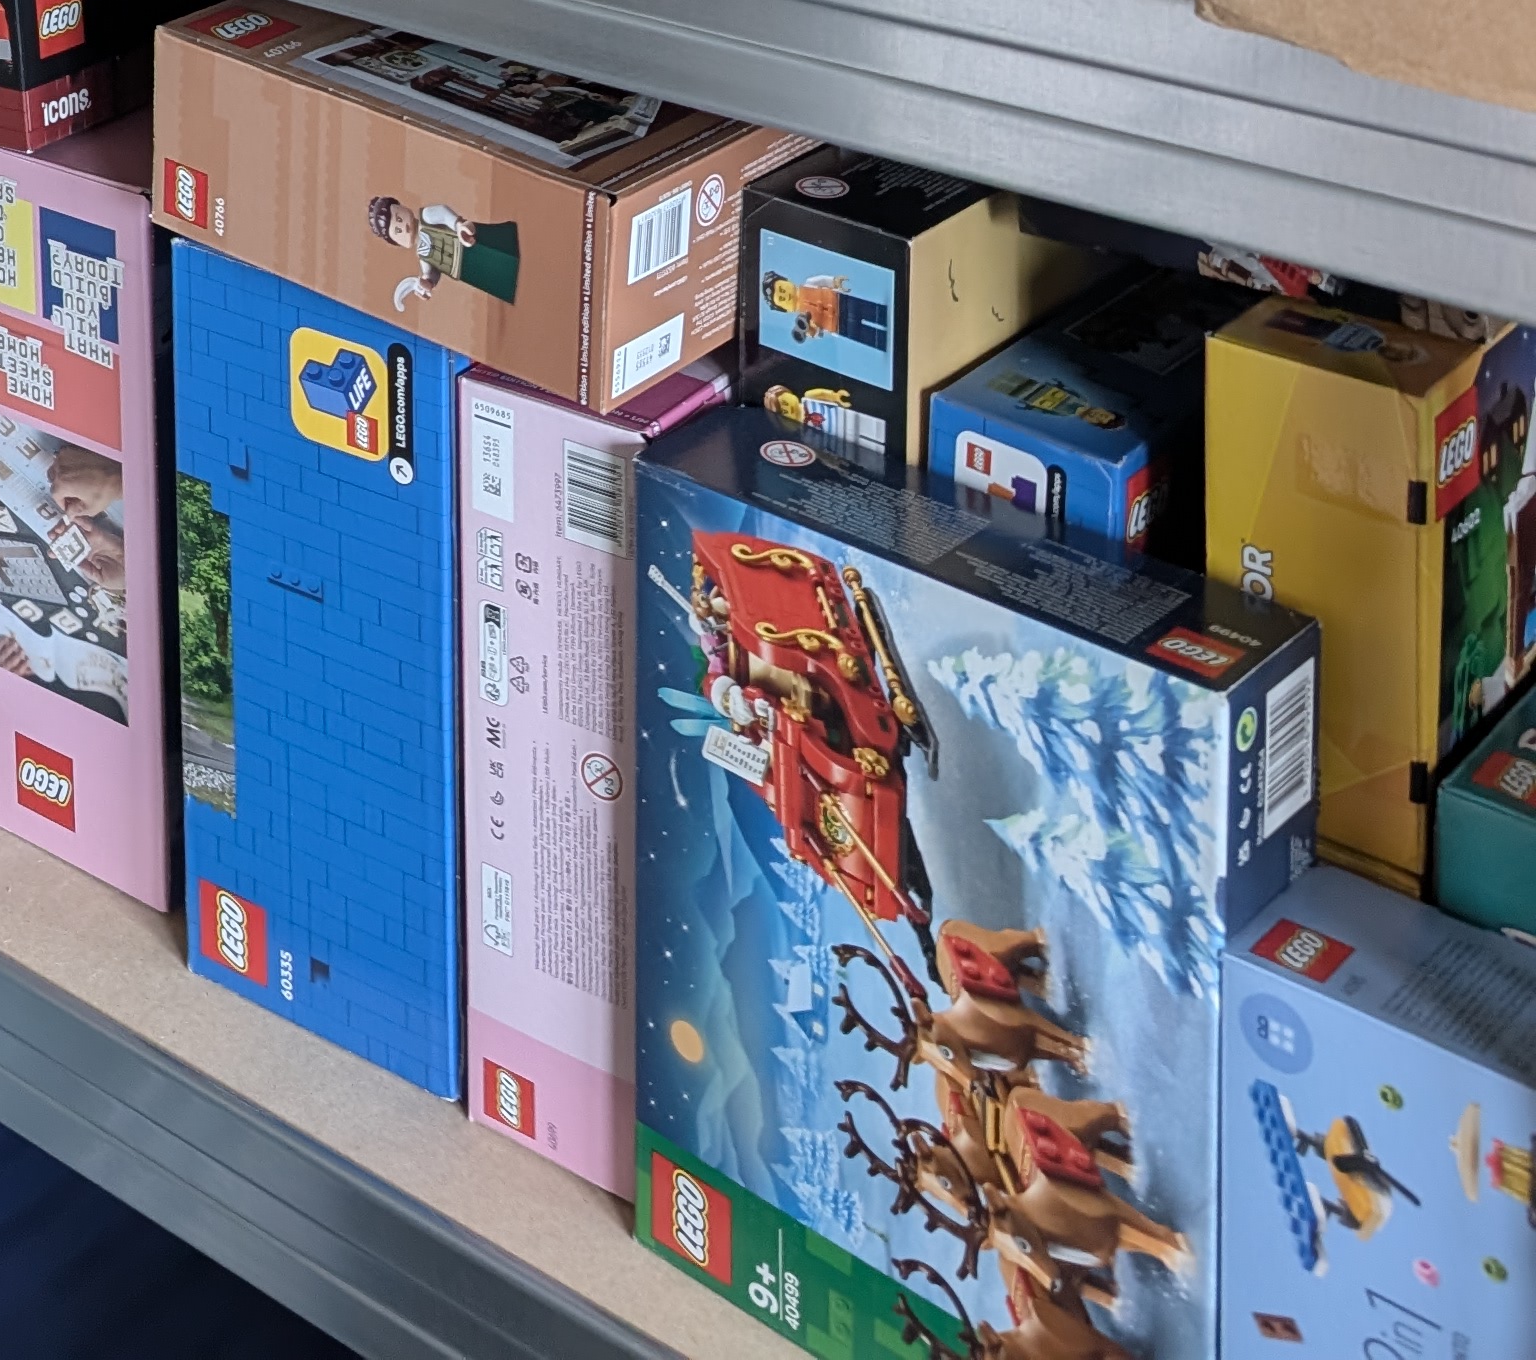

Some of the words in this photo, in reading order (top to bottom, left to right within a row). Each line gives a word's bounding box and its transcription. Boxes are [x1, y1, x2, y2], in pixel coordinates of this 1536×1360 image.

[39, 0, 81, 37] LEGO
[215, 13, 271, 41] LEGO
[263, 41, 302, 59] 40766
[175, 165, 197, 221] LEGO
[215, 196, 225, 236] 40766
[585, 229, 595, 262] edition
[53, 269, 109, 303] BUILD
[583, 262, 592, 297] Limited
[64, 293, 97, 319] YOU
[581, 302, 591, 335] edition
[53, 309, 98, 340] WILL
[67, 333, 112, 366] WHAT
[580, 336, 590, 368] Limited
[8, 376, 53, 408] HOME
[347, 365, 373, 413] LIFE
[394, 354, 408, 449] LEGO.com/apps
[474, 401, 512, 421] 6509685
[352, 414, 368, 450] LEGO
[973, 448, 985, 472] LEGO
[1438, 419, 1477, 484] LEGO
[1164, 636, 1233, 668] LEGO
[19, 758, 71, 807] LEGO
[219, 889, 250, 975] LEGO
[1280, 931, 1326, 968] LEGO
[280, 950, 295, 1002] 60335
[497, 1066, 522, 1132] LEGO
[670, 1171, 710, 1268] LEGO
[747, 1260, 779, 1315] 9+
[781, 1271, 802, 1332] 40499
